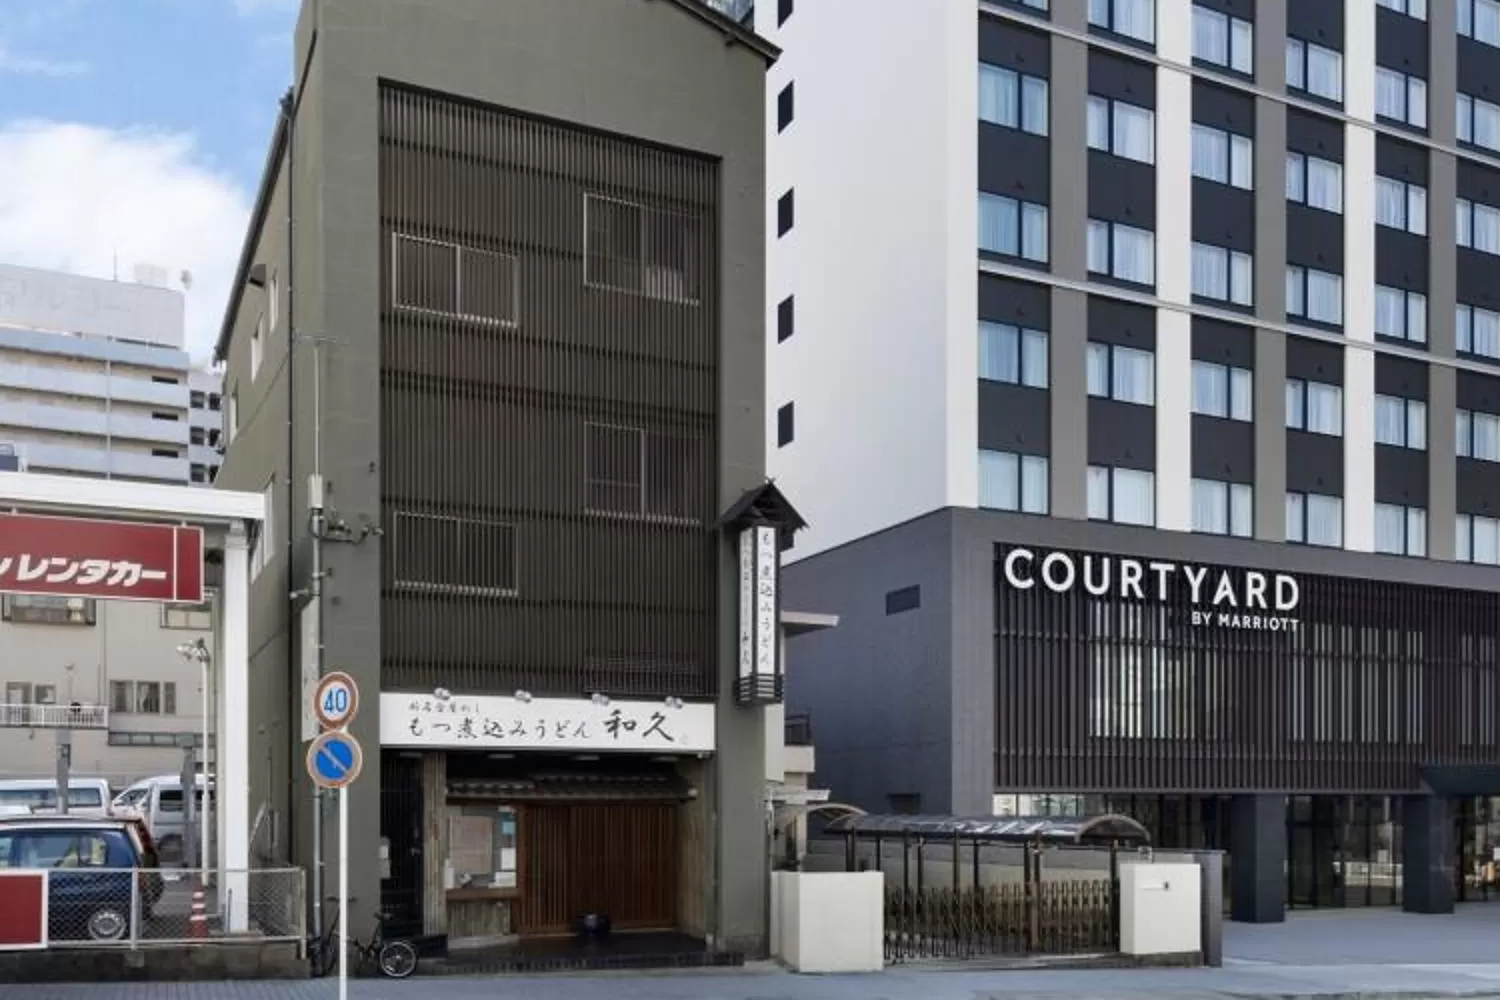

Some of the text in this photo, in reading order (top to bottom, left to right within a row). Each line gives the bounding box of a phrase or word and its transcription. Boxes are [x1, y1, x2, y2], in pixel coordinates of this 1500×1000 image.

[1004, 548, 1299, 611] COURTYARD
[1192, 611, 1299, 631] BY MARRIOTT
[324, 688, 348, 713] 40
[603, 708, 674, 742] 和久
